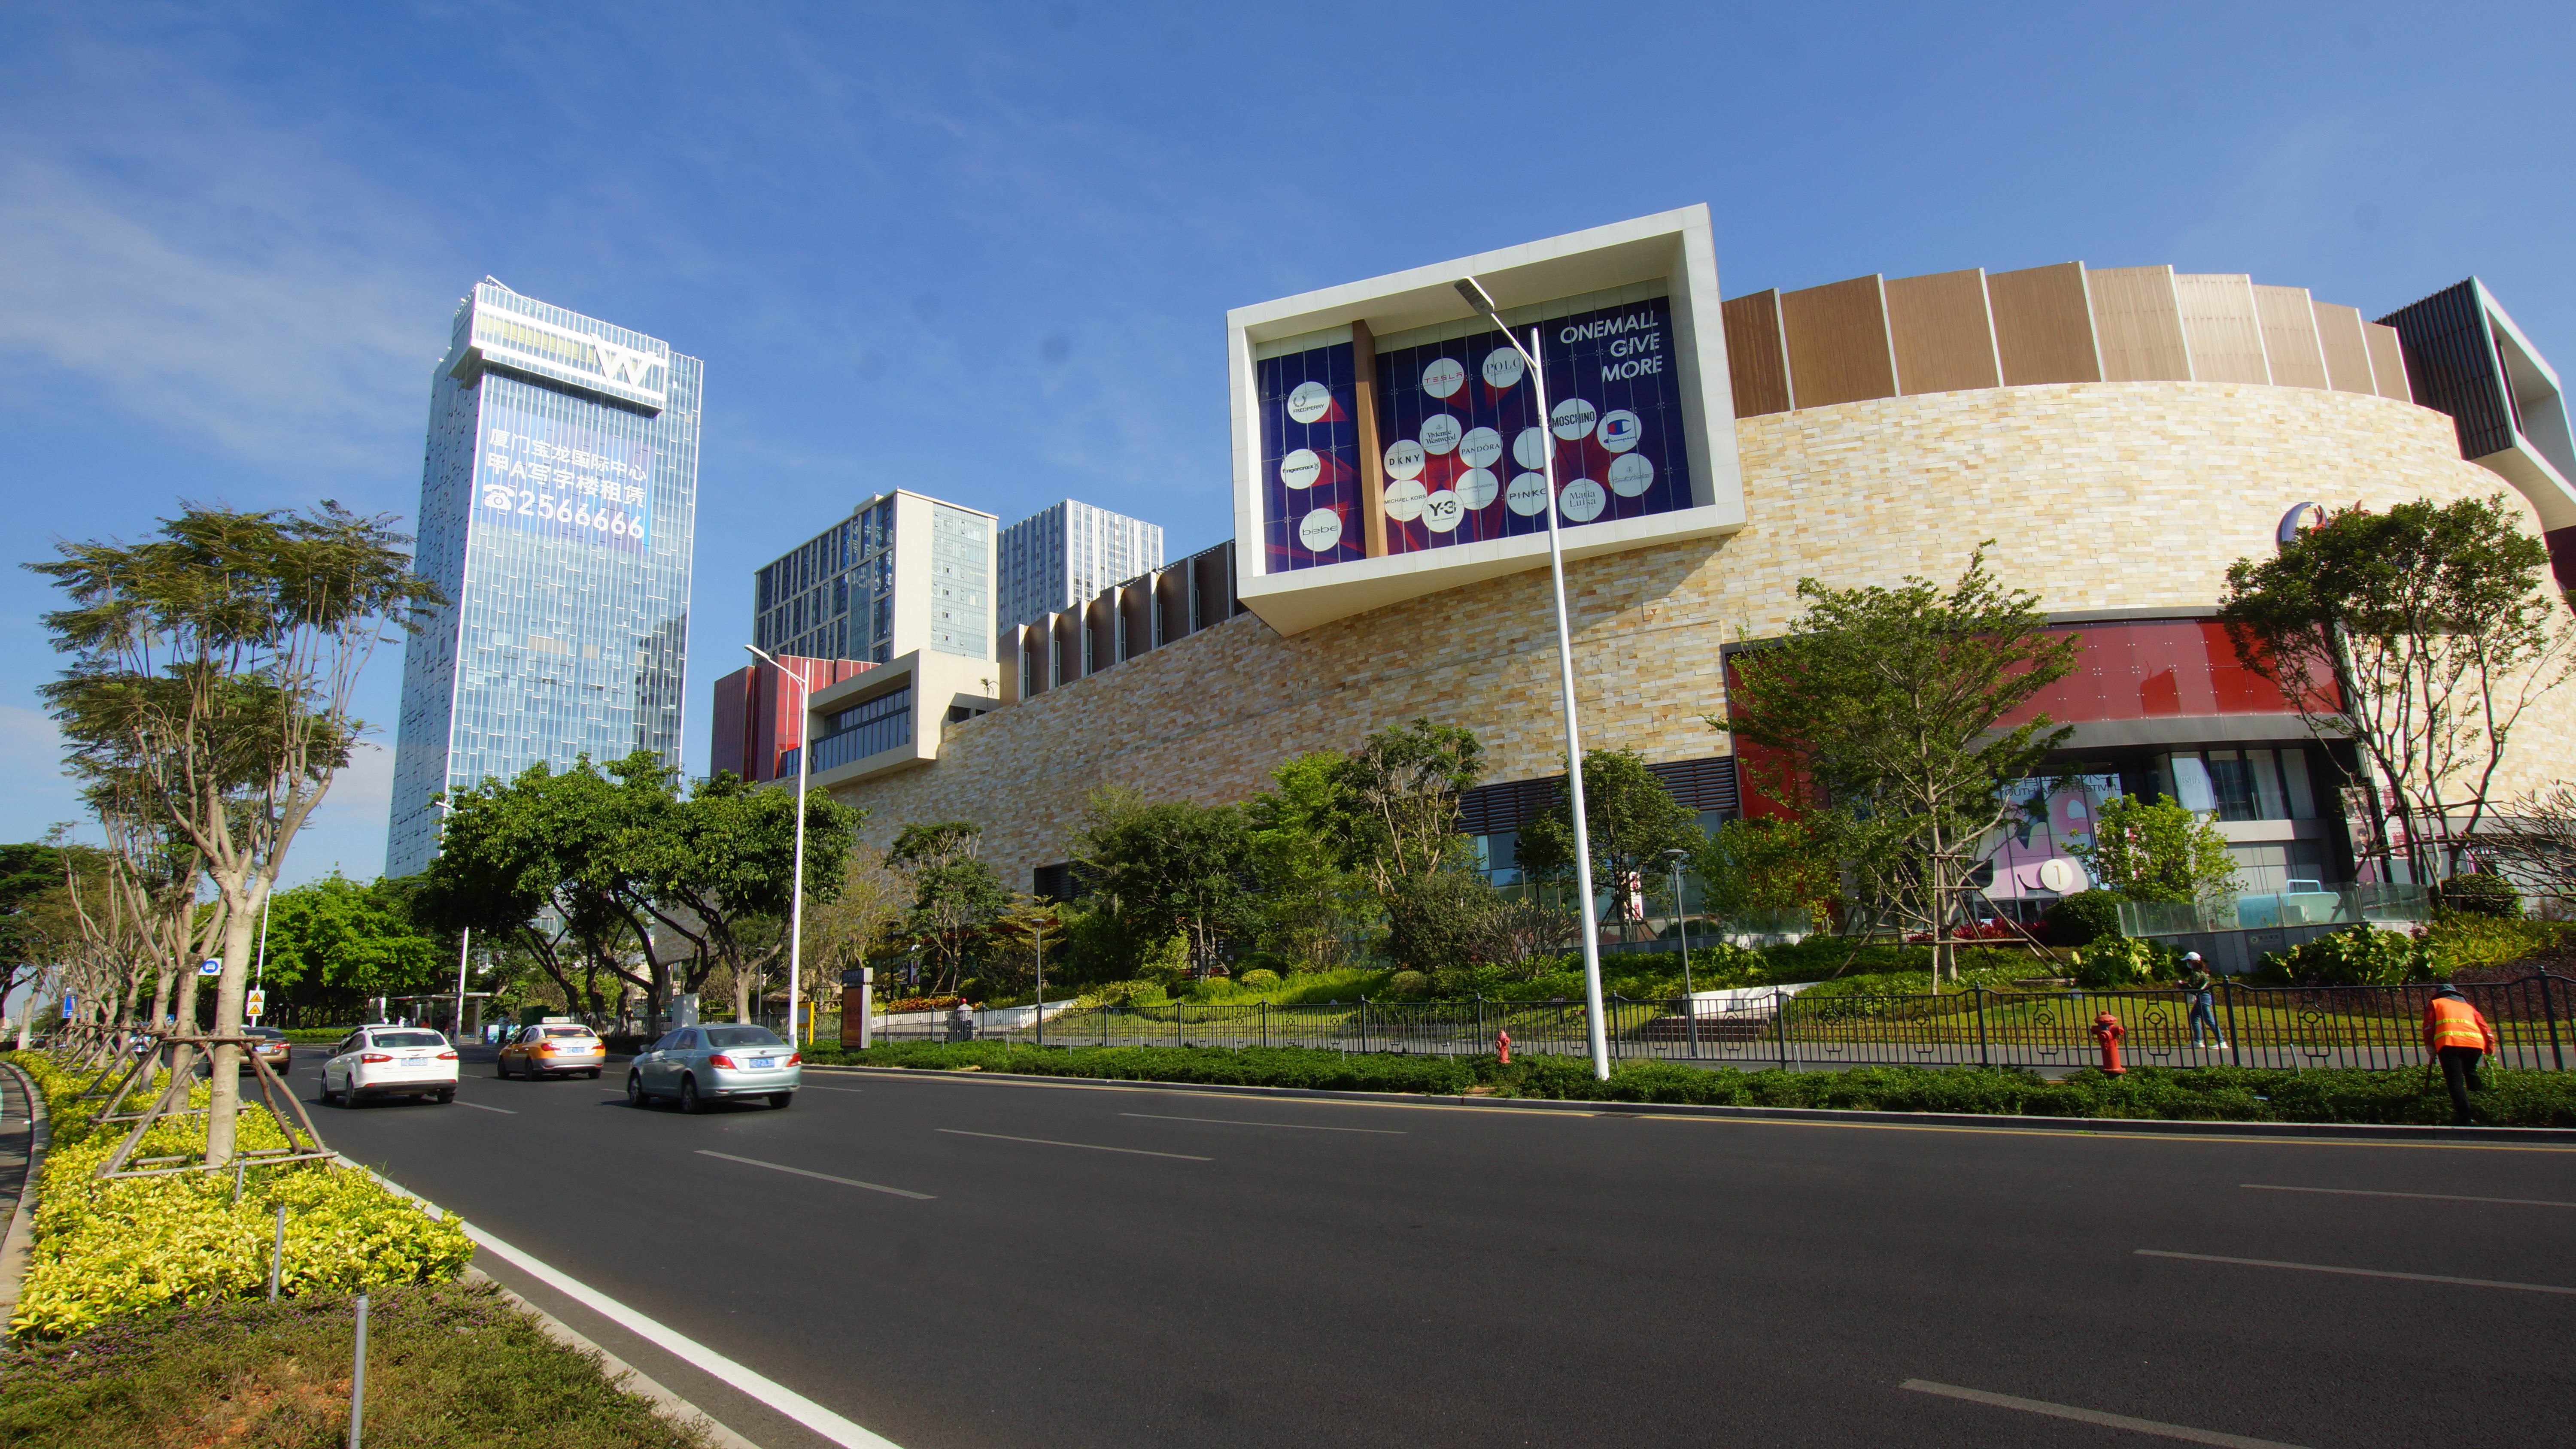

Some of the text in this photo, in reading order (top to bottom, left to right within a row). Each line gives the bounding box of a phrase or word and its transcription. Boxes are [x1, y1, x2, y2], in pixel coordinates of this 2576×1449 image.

[1560, 310, 1658, 343] ONEMALL
[1610, 332, 1660, 357] GIVE
[1602, 355, 1663, 382] MORE
[1424, 372, 1462, 383] TESLA
[1552, 411, 1595, 428] MOSCHINO
[1425, 433, 1456, 445] Westwood
[489, 428, 647, 481] 厦门宝龙国际中心
[1389, 454, 1420, 466] DKNY
[1570, 491, 1595, 500] Maria
[1570, 498, 1596, 507] Luisa
[518, 491, 644, 539] 2566666
[1428, 500, 1456, 516] Y-3
[1303, 525, 1338, 536] bebe
[2071, 784, 2121, 792] FESTIVL
